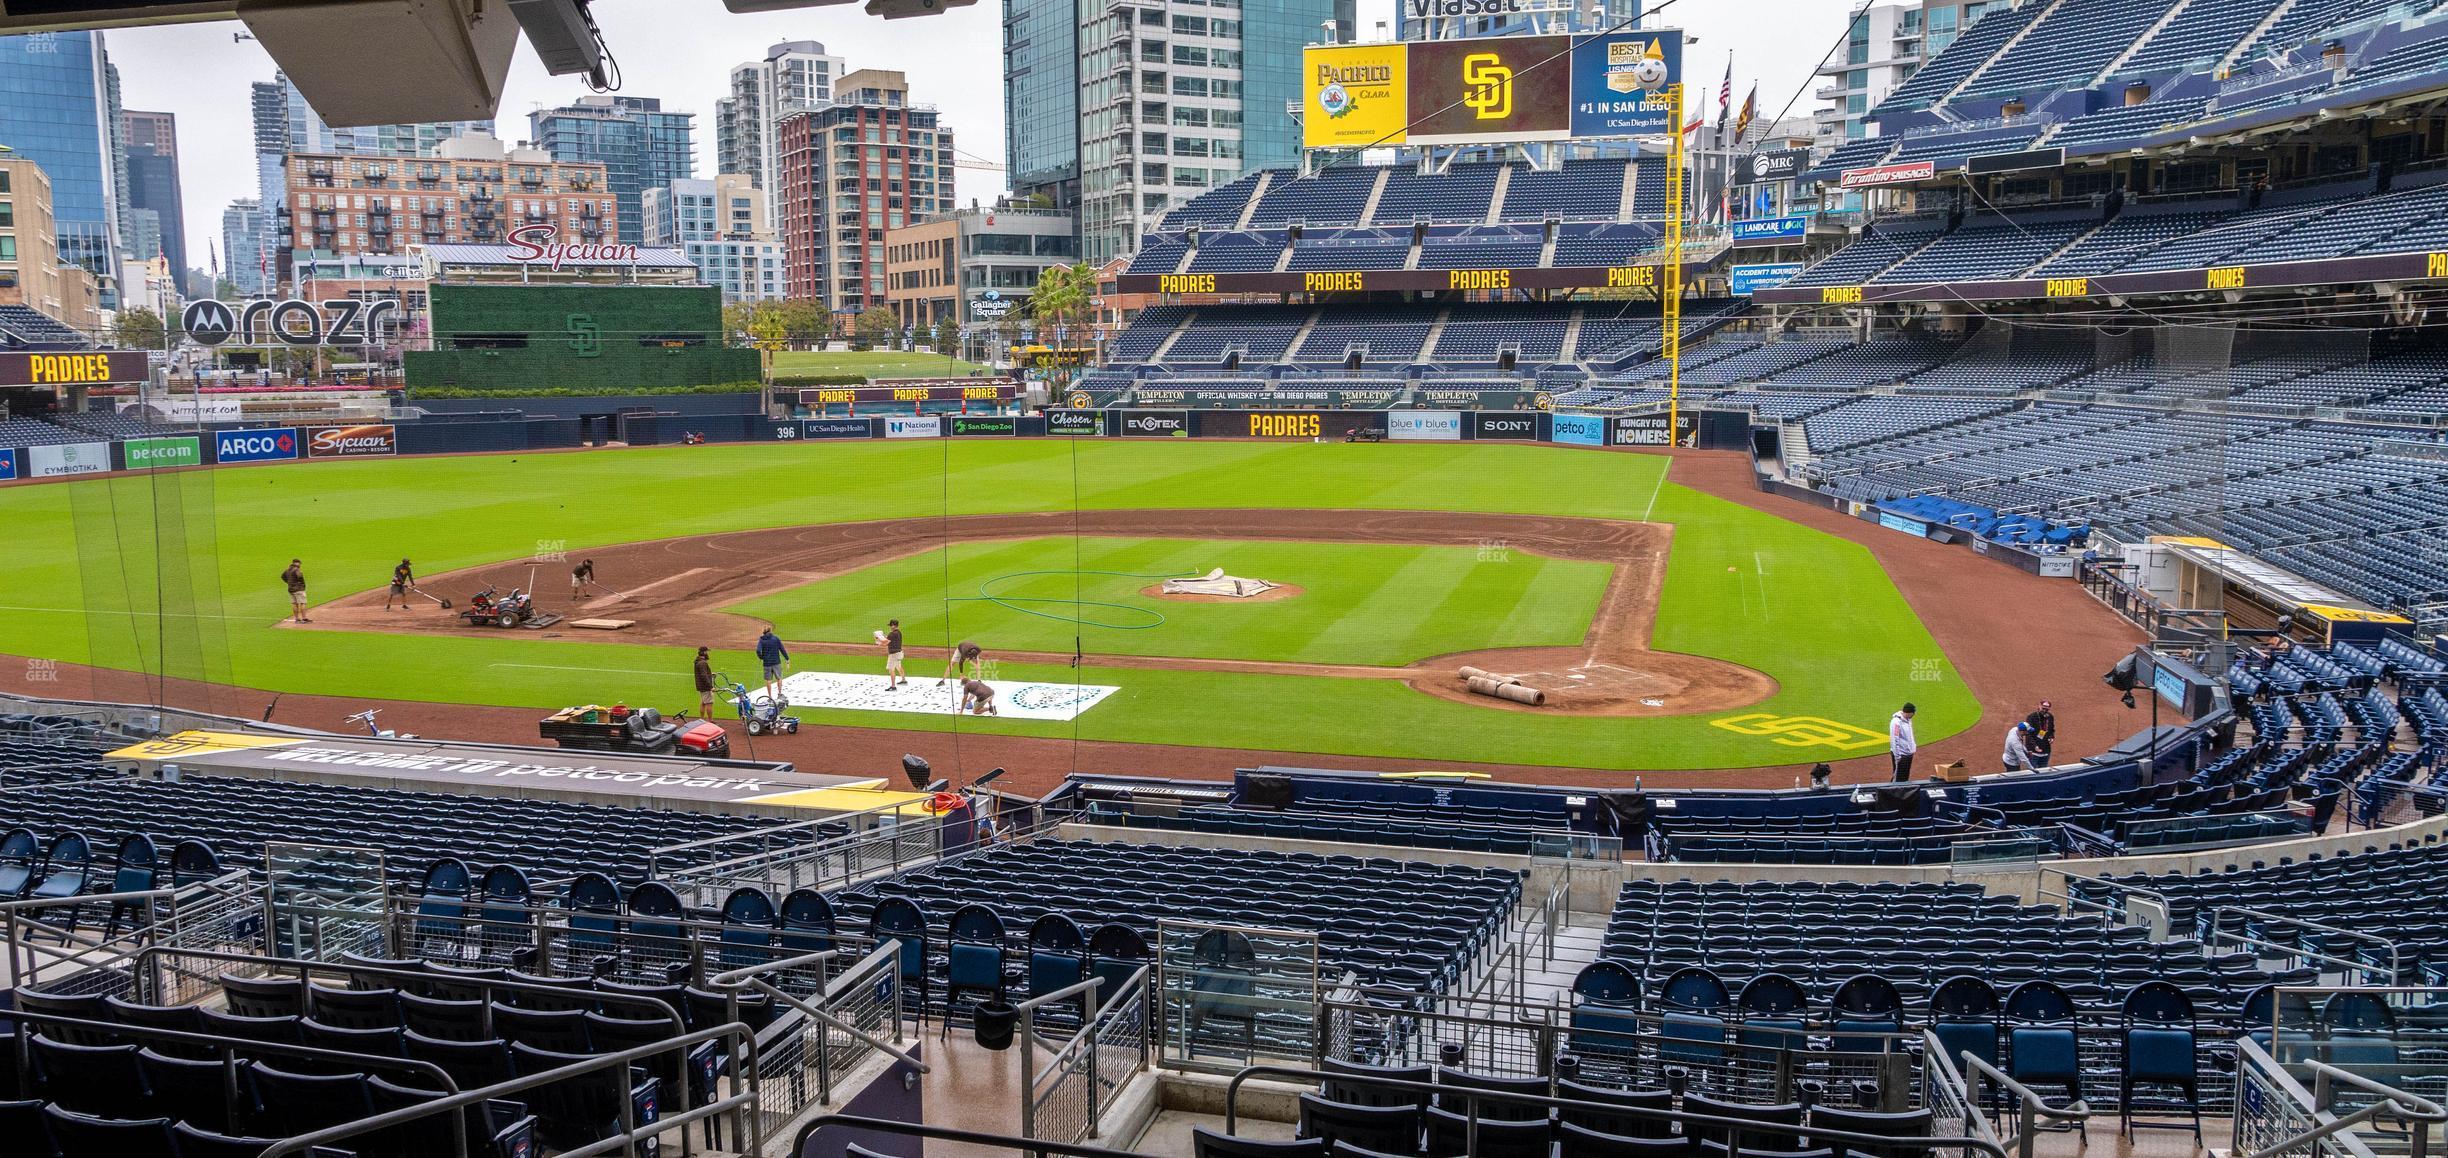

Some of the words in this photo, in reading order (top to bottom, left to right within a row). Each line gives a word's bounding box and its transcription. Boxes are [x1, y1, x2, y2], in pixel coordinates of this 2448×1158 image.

[1611, 44, 1643, 55] BEST
[1610, 55, 1643, 64] HOSPITALS
[1580, 103, 1594, 113] #1
[1598, 103, 1609, 113] IN
[1613, 102, 1635, 112] SAN
[1631, 119, 1649, 127] Diego
[1769, 156, 1794, 169] MRC
[1843, 169, 1890, 185] Tarantino
[1891, 168, 1931, 180] SAUSAGES
[1745, 222, 1779, 232] LANDCARE
[1781, 220, 1803, 230] LOGIC
[506, 224, 641, 272] Sycuan
[1305, 272, 1362, 291] PADRES
[1450, 270, 1509, 288] PADRES
[1608, 266, 1653, 287] PADRES
[2207, 267, 2246, 289] PADRES
[1160, 274, 1216, 293] PADRES
[2046, 278, 2088, 297] PADRES
[1823, 287, 1862, 302] PADRES
[971, 300, 1011, 309] Gallagher
[976, 308, 1005, 317] Square
[241, 299, 399, 345] razr
[30, 354, 110, 383] PADRES
[819, 390, 856, 402] PADRES
[894, 389, 929, 401] PADRES
[963, 387, 998, 399] PADRES
[1136, 391, 1185, 399] TEMPLETON
[1340, 392, 1392, 400] TEMPLETON
[1425, 392, 1479, 400] TEMPLETON
[1051, 412, 1092, 424] Chosen
[1391, 419, 1412, 428] blue
[1425, 419, 1447, 428] blue
[1620, 419, 1651, 428] HUNGRY
[1652, 418, 1667, 427] FOR
[830, 425, 847, 433] Diego
[980, 423, 998, 431] Diego
[1250, 414, 1320, 437] PADRES
[1484, 421, 1531, 431] SONY
[1555, 422, 1584, 435] petco
[777, 427, 795, 439] 396
[1616, 429, 1670, 444] HOMERS
[220, 437, 275, 455] ARCO
[314, 429, 388, 455] Sycuan
[44, 464, 98, 474] CYMBIOTIKA
[263, 747, 457, 770] WELCOME
[497, 763, 651, 780] petco
[642, 772, 770, 792] park
[244, 922, 251, 932] A
